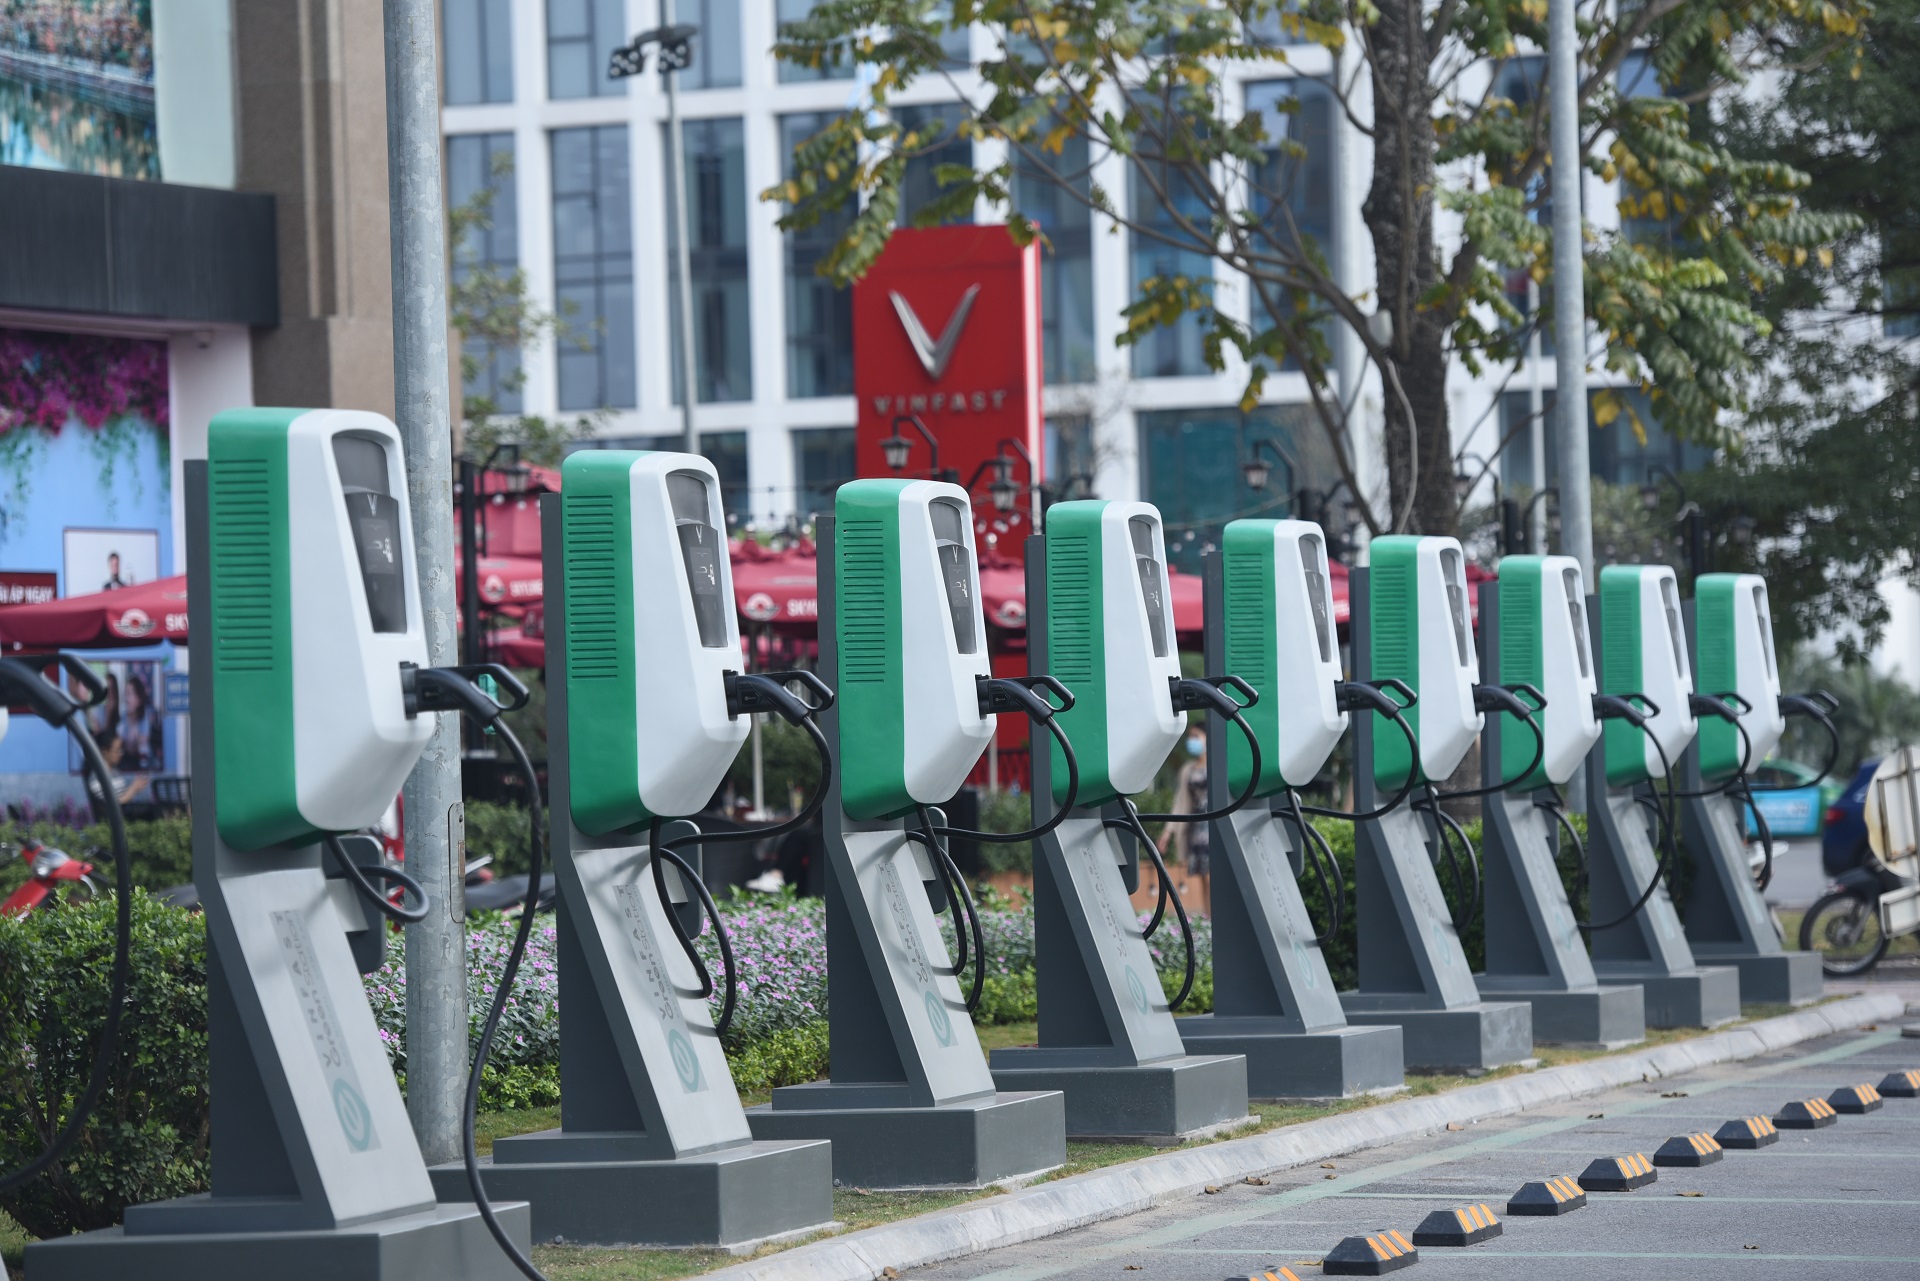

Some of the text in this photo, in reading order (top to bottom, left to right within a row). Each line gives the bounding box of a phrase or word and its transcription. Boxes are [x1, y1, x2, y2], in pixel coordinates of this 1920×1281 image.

[873, 389, 1008, 416] VINFAST
[25, 585, 55, 605] NGAY
[284, 910, 314, 986] Station
[616, 886, 666, 1020] VINFAST
[625, 884, 650, 951] Station
[273, 911, 331, 1068] VINFAST
[648, 953, 674, 1020] Green
[312, 989, 341, 1067] Green
